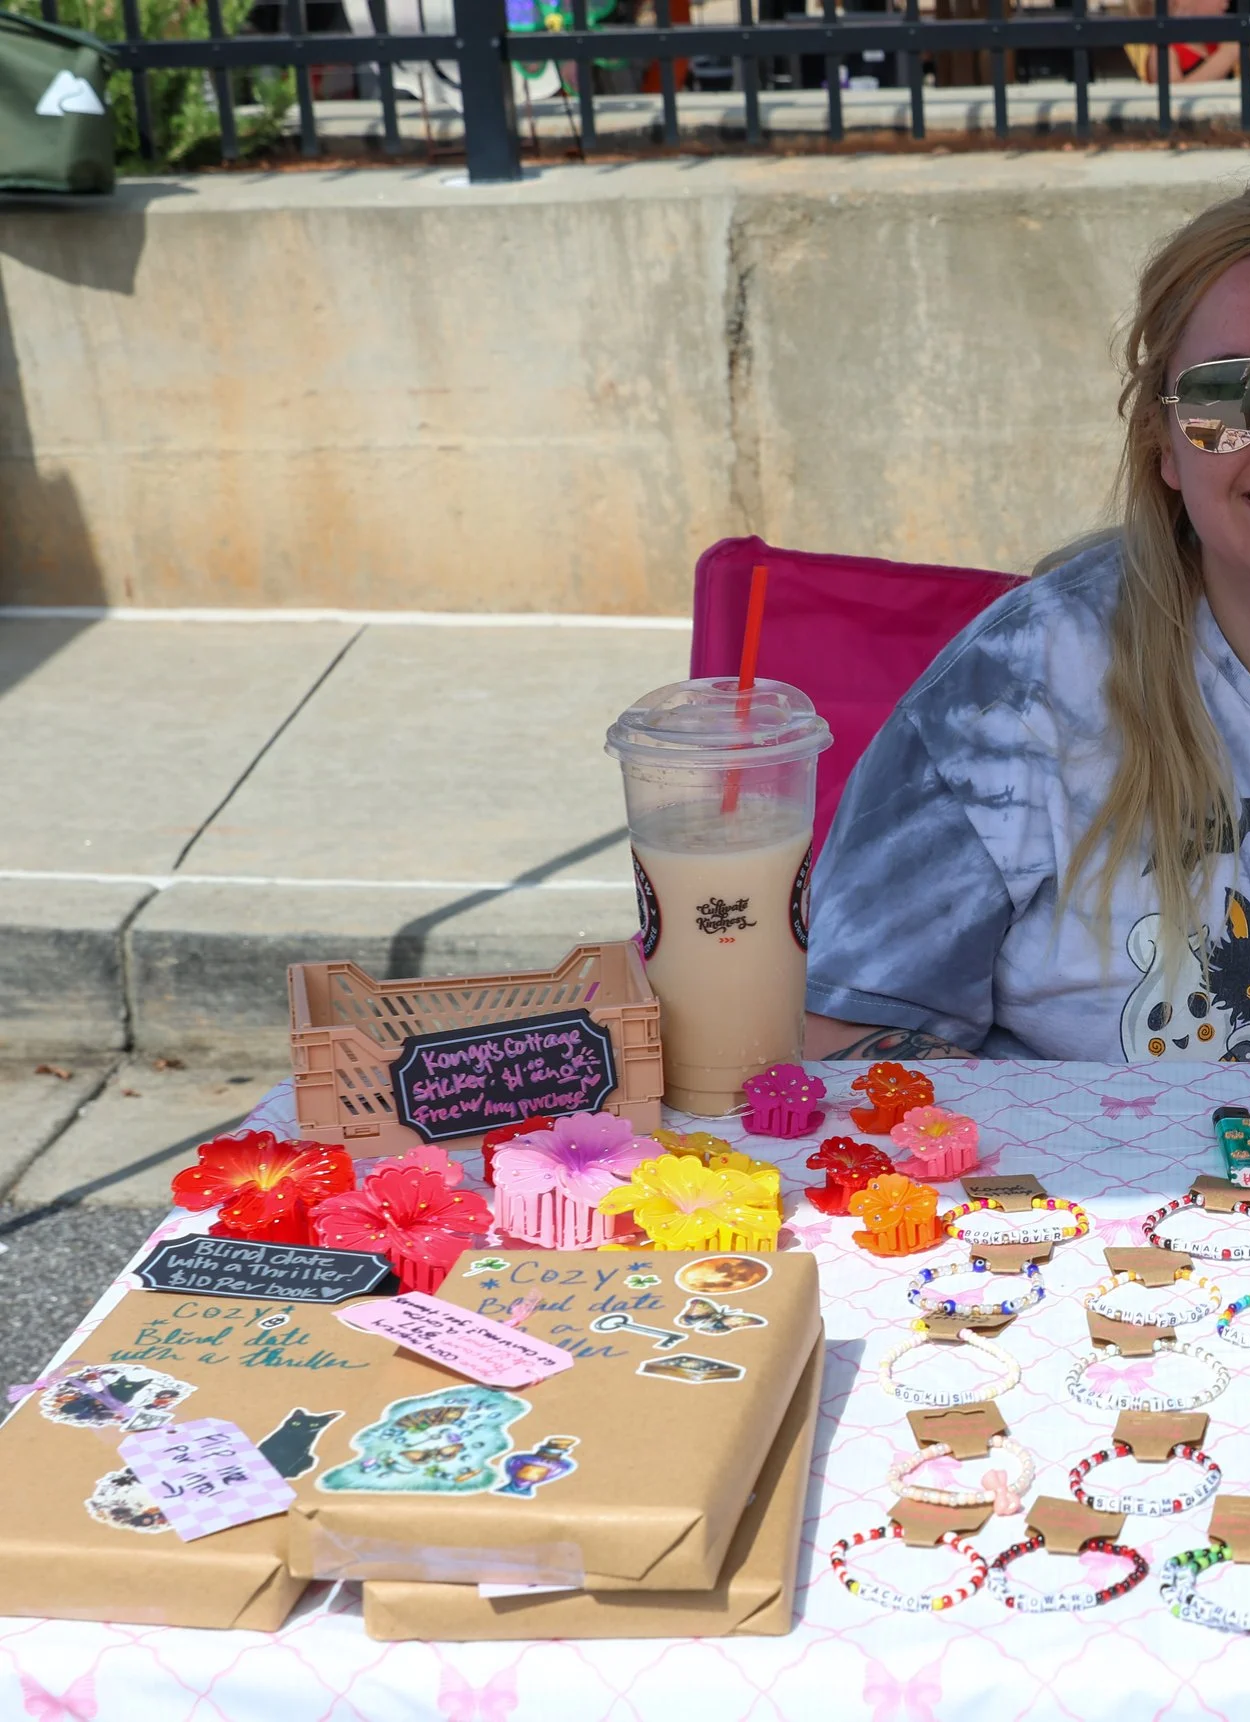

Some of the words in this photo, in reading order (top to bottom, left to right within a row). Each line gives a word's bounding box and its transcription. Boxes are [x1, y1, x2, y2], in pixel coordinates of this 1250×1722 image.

[696, 897, 750, 915] Cultivate
[696, 914, 757, 934] Kindness
[1011, 1227, 1061, 1243] LOVER
[167, 1253, 213, 1270] with
[226, 1262, 243, 1273] a
[195, 1241, 265, 1263] Blind
[270, 1248, 335, 1267] date
[169, 1272, 213, 1288] $10
[265, 1284, 320, 1298] book
[478, 1297, 574, 1316] Blnd
[589, 1294, 668, 1313] date
[199, 1351, 230, 1364] a
[895, 1385, 974, 1404] BOOKISH
[1153, 1397, 1184, 1409] ICE
[1096, 1496, 1172, 1516] SCREAM
